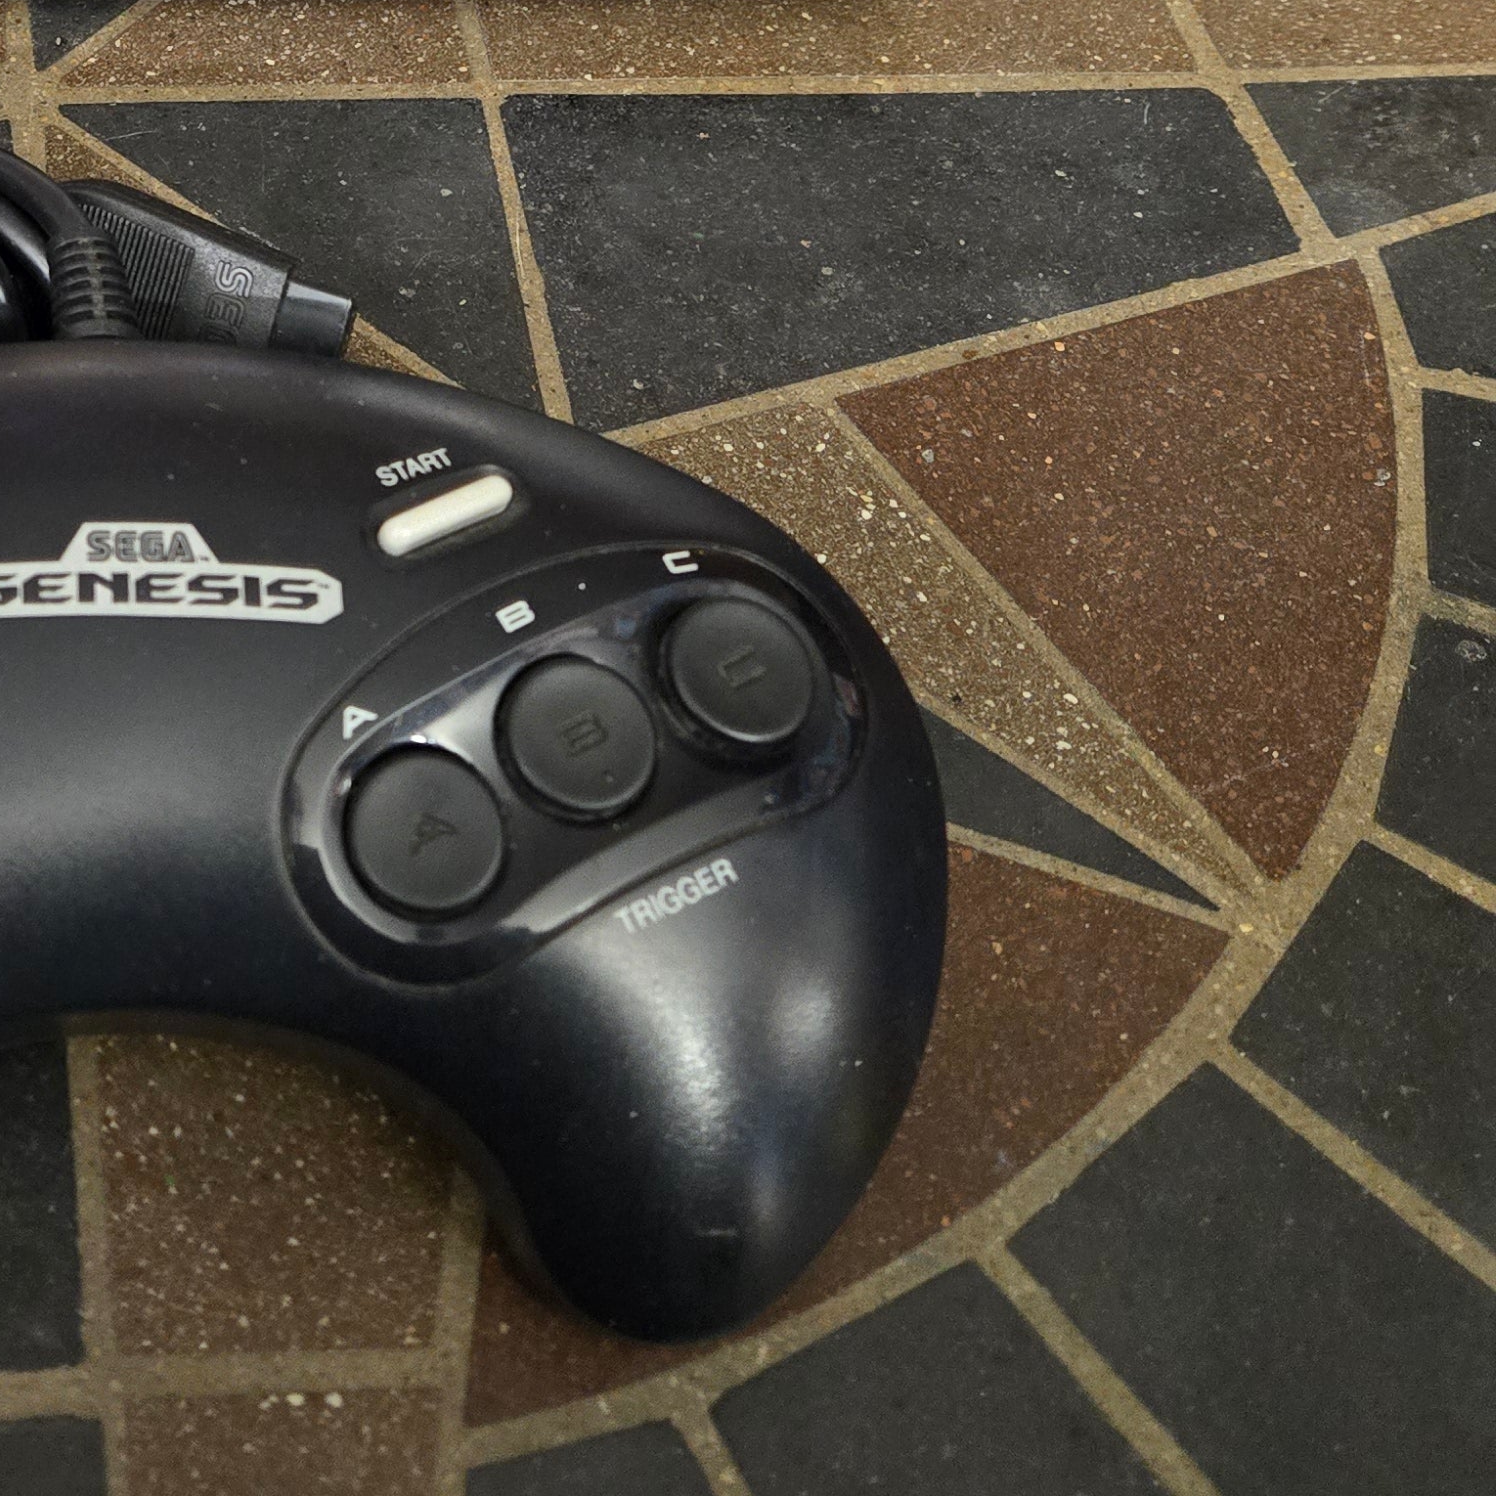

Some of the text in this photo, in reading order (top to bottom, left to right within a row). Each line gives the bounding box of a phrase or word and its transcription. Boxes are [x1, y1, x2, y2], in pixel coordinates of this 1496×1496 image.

[376, 448, 452, 489] START
[86, 529, 196, 562] SEGA
[663, 550, 699, 576] C
[495, 600, 536, 634] B
[341, 704, 378, 740] A
[614, 858, 740, 936] TRIGGER
